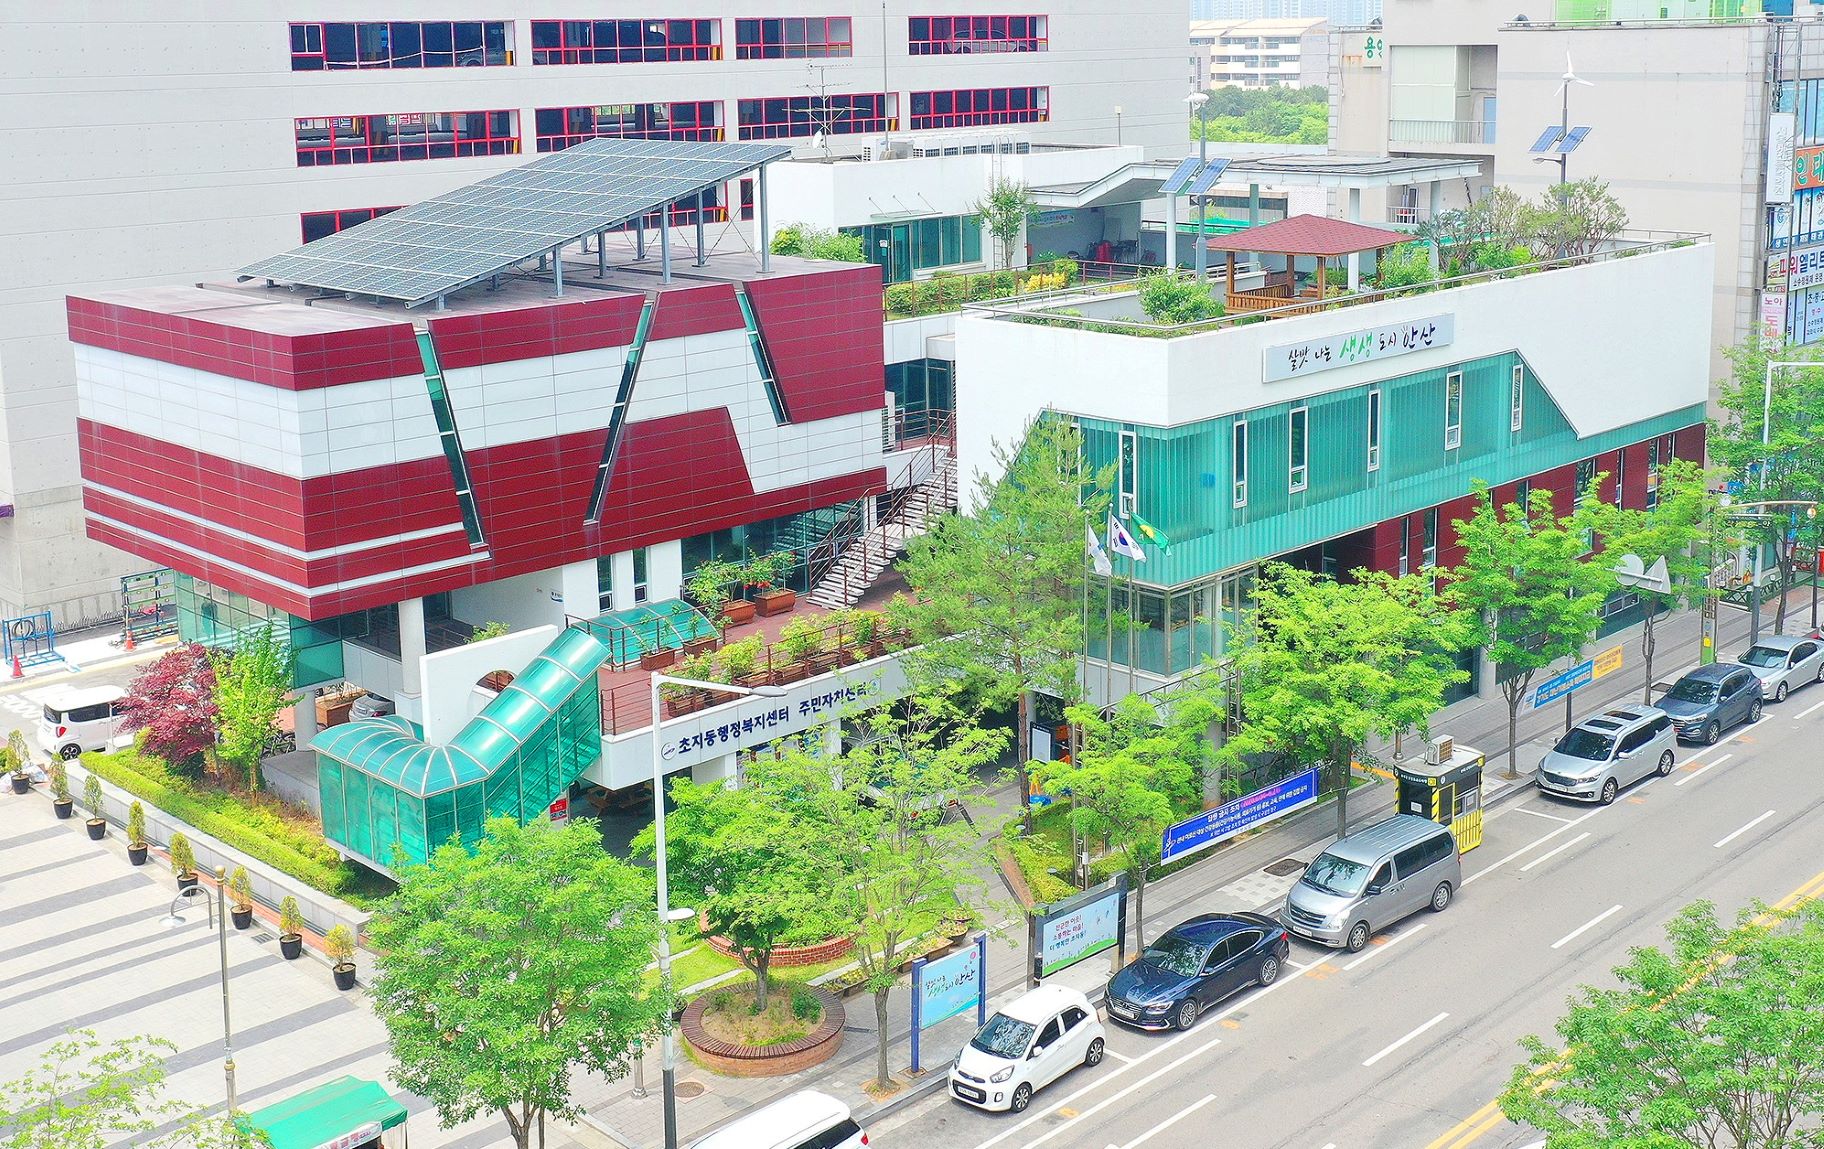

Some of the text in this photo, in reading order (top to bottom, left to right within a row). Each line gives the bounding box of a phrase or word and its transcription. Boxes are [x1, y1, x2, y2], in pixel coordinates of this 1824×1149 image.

[1289, 323, 1436, 371] 살맛 나는 생생 도시 안산
[678, 706, 790, 754] 초지동행정복지센터
